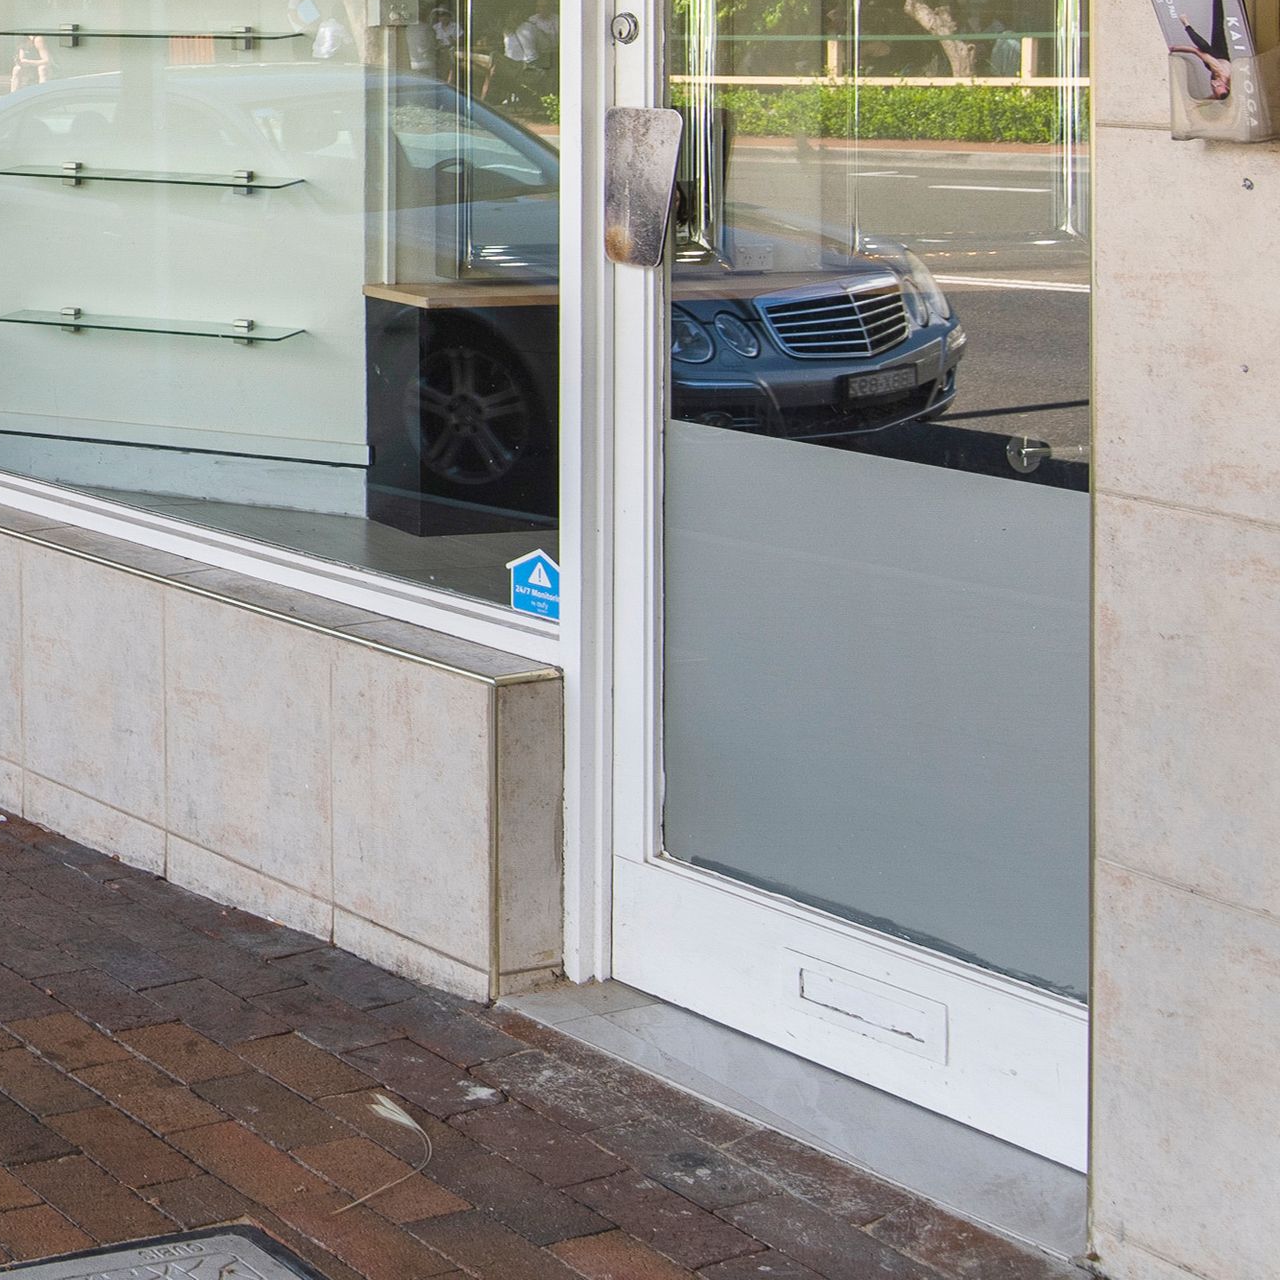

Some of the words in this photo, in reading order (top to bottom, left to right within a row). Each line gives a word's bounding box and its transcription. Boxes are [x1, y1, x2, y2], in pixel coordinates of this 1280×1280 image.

[1226, 16, 1245, 51] KAI
[1239, 64, 1259, 128] YOGA
[515, 584, 531, 595] 24/7
